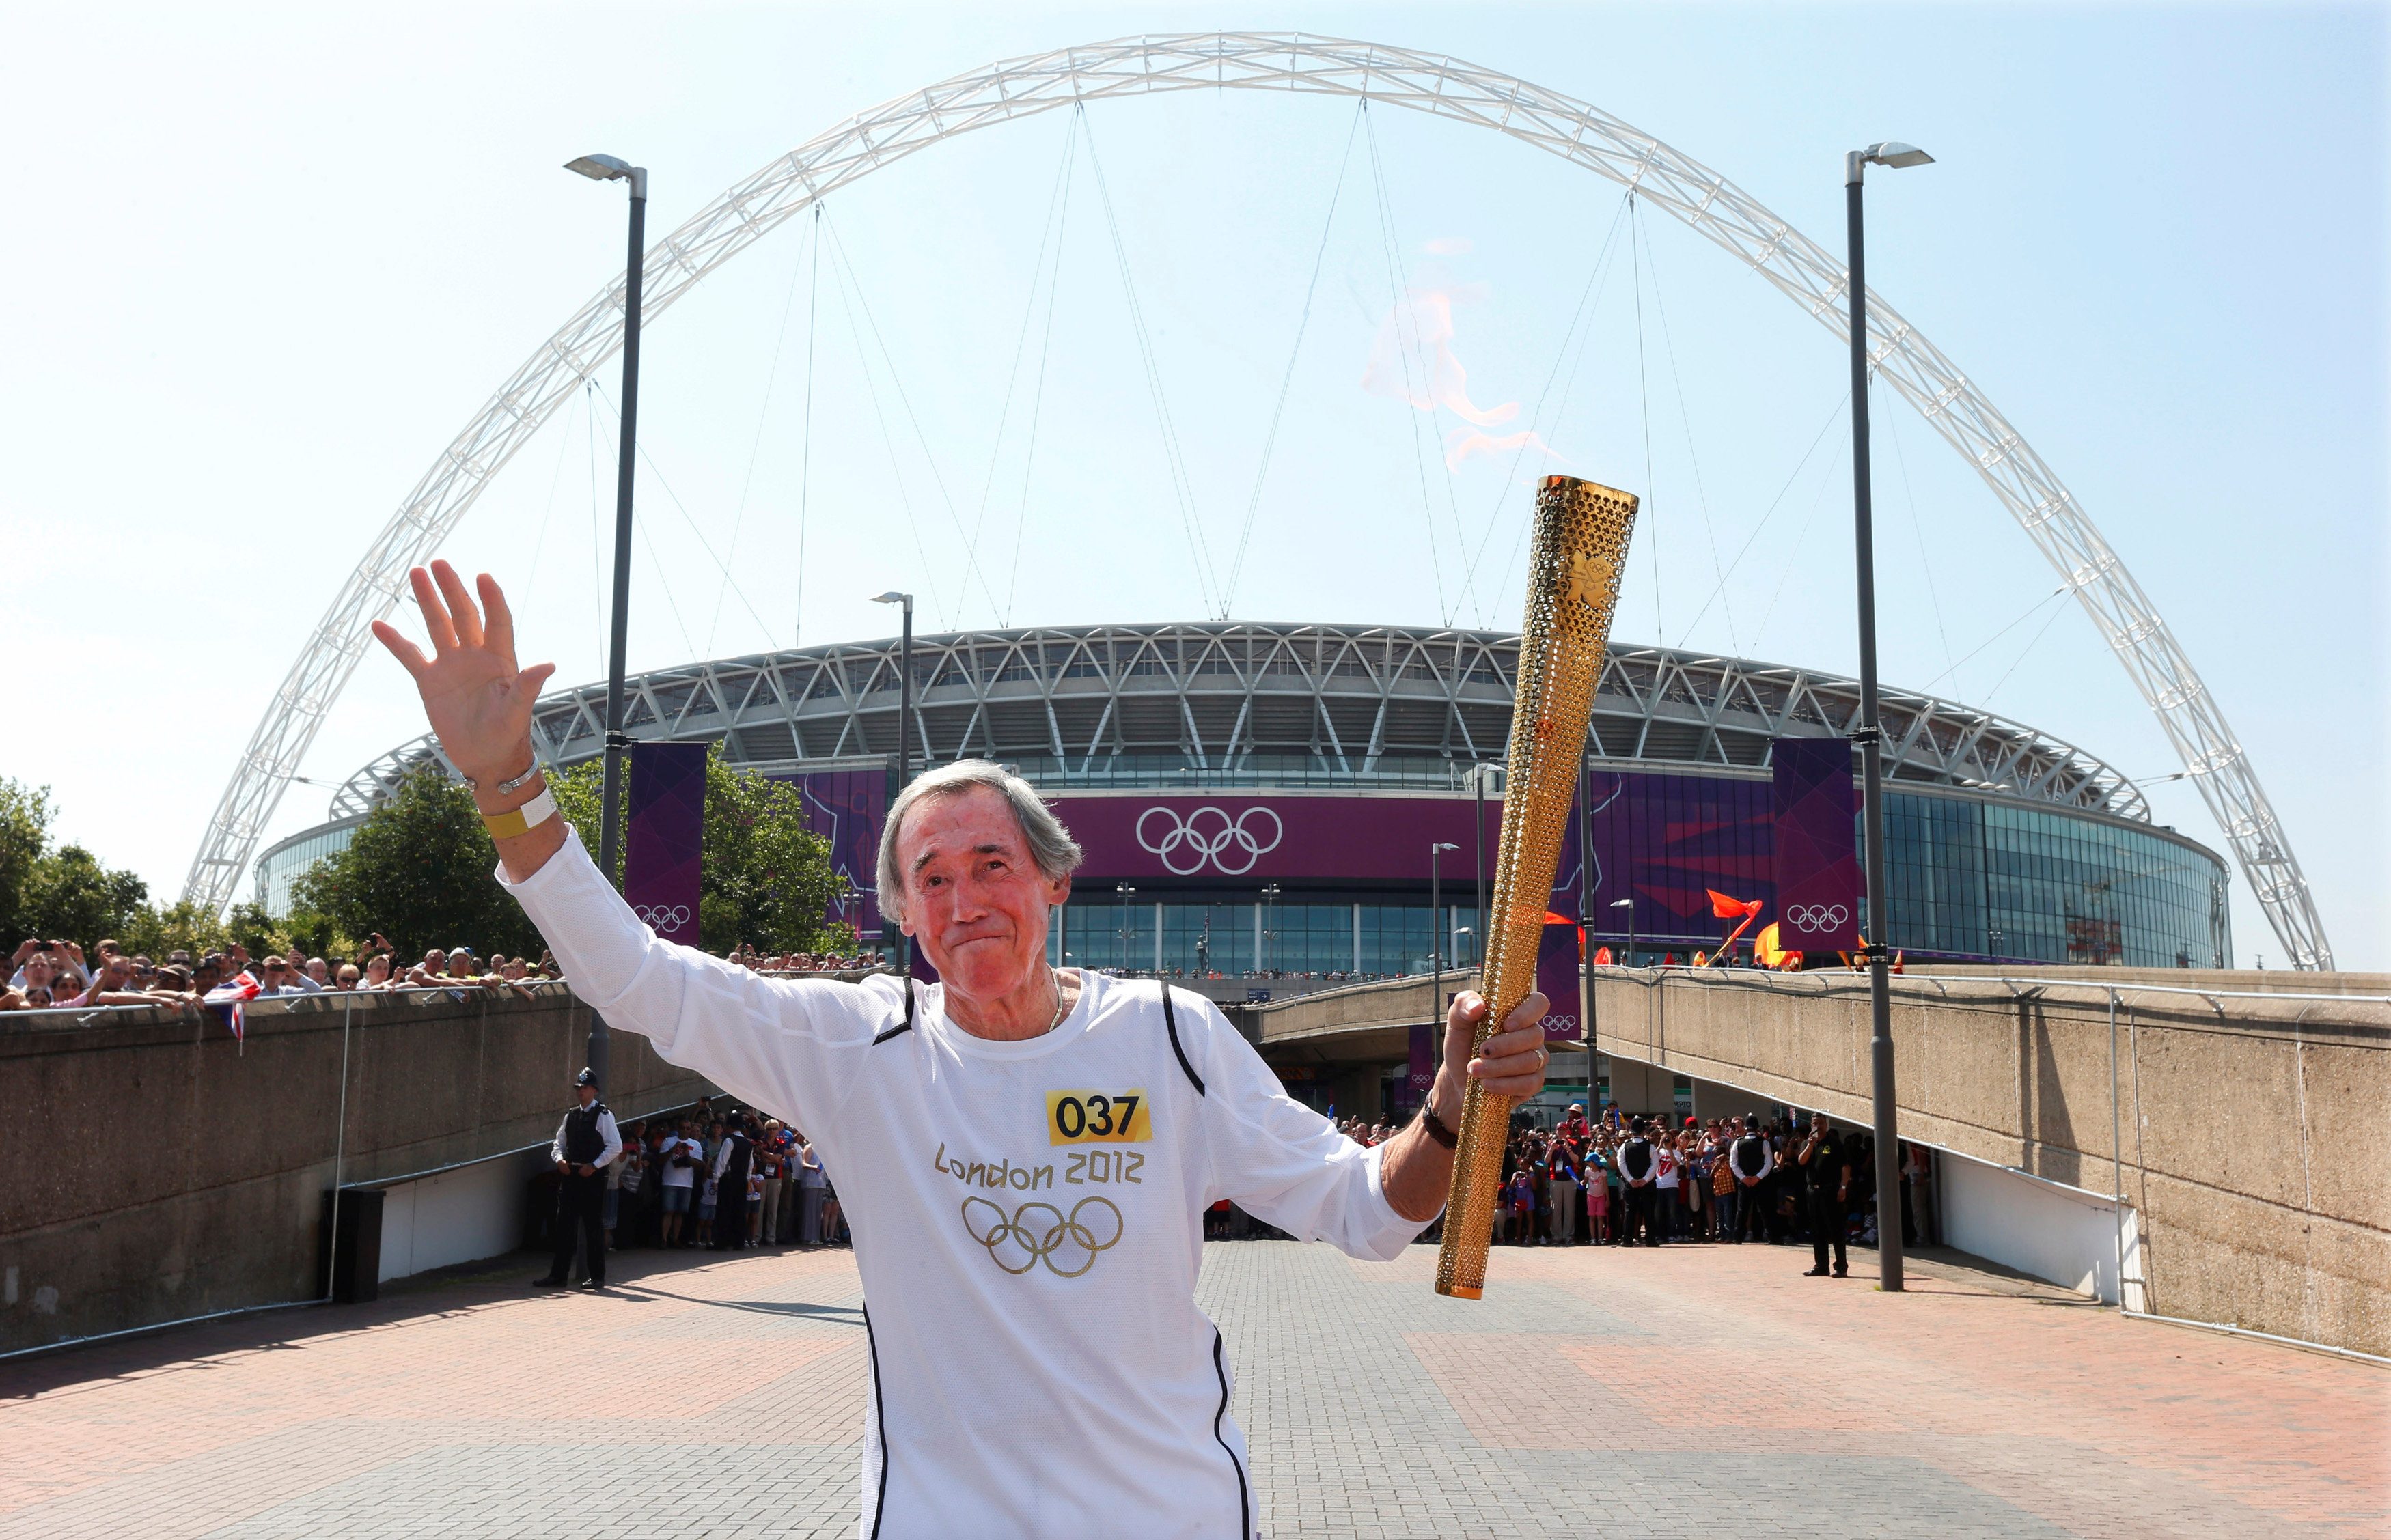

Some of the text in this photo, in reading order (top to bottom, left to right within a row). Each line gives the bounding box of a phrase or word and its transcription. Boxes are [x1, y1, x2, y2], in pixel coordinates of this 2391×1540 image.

[1055, 1095, 1140, 1138] 037
[935, 1142, 1145, 1191] London 2012
